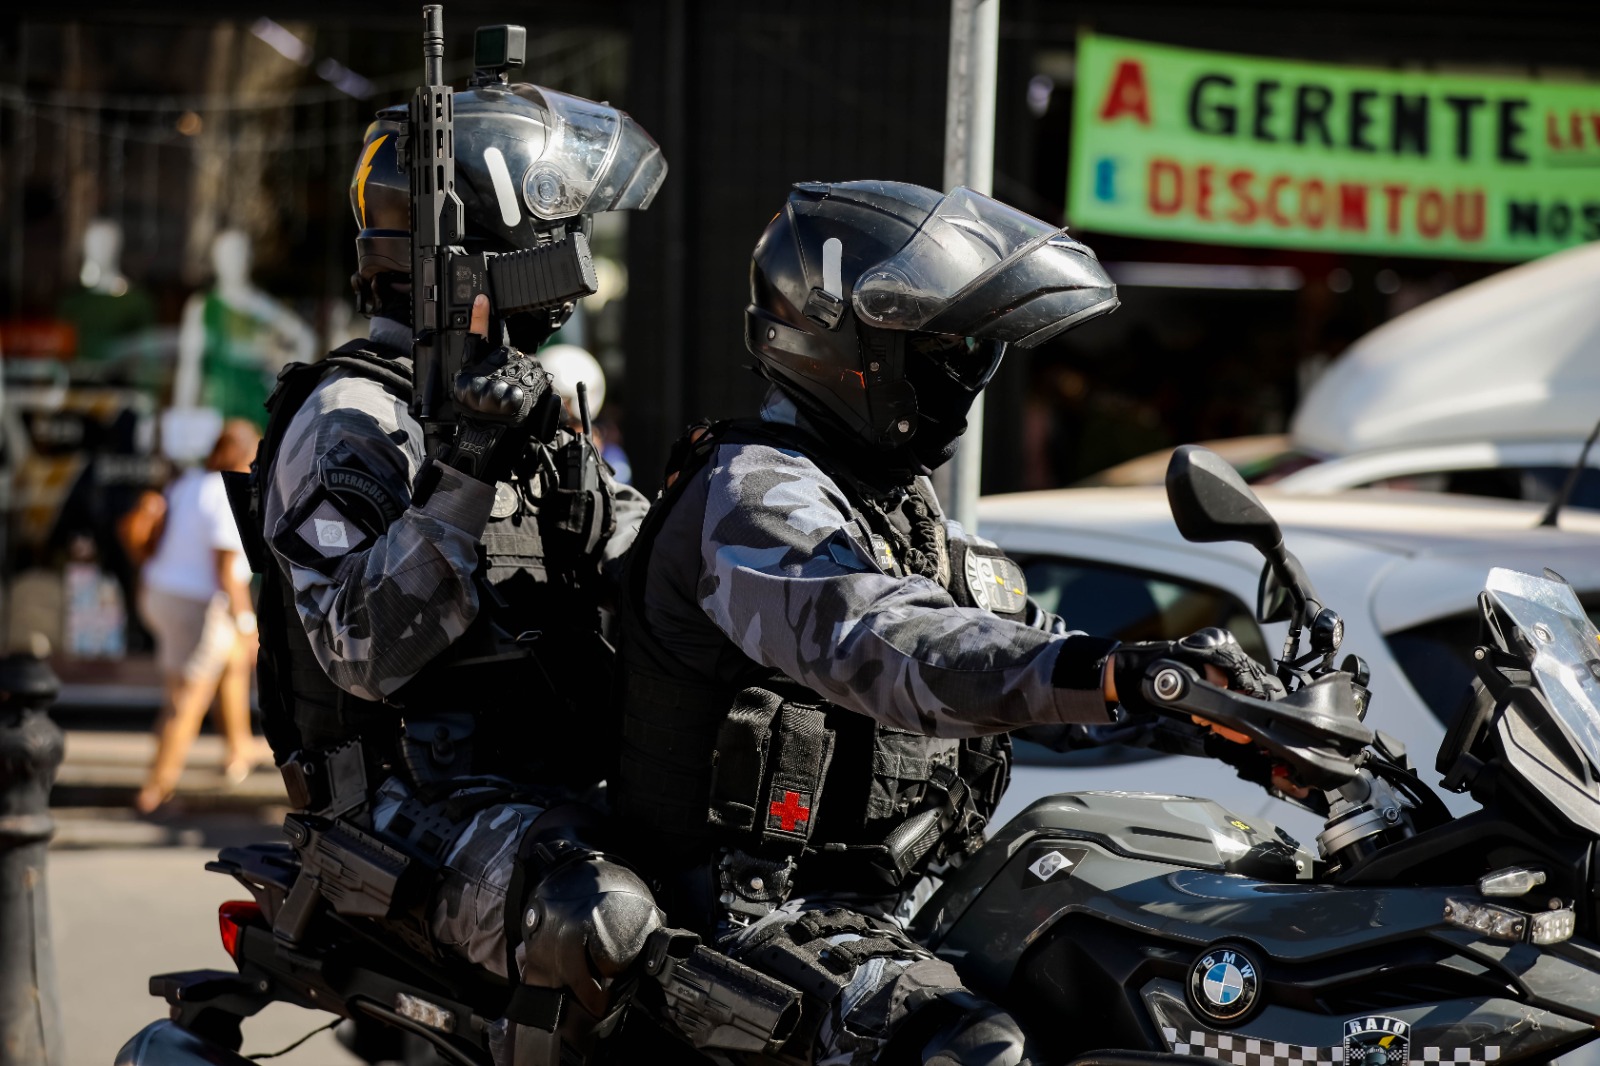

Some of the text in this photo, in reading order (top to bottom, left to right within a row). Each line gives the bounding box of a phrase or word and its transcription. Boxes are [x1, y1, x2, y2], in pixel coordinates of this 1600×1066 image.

[1096, 58, 1151, 125] A
[1187, 73, 1530, 164] GERENTE
[1148, 157, 1487, 243] DESCONTOU
[1506, 199, 1600, 244] NOS
[330, 472, 388, 504] OPERAÇÕES
[1202, 951, 1253, 978] BMW
[1349, 1018, 1406, 1034] RAIO
